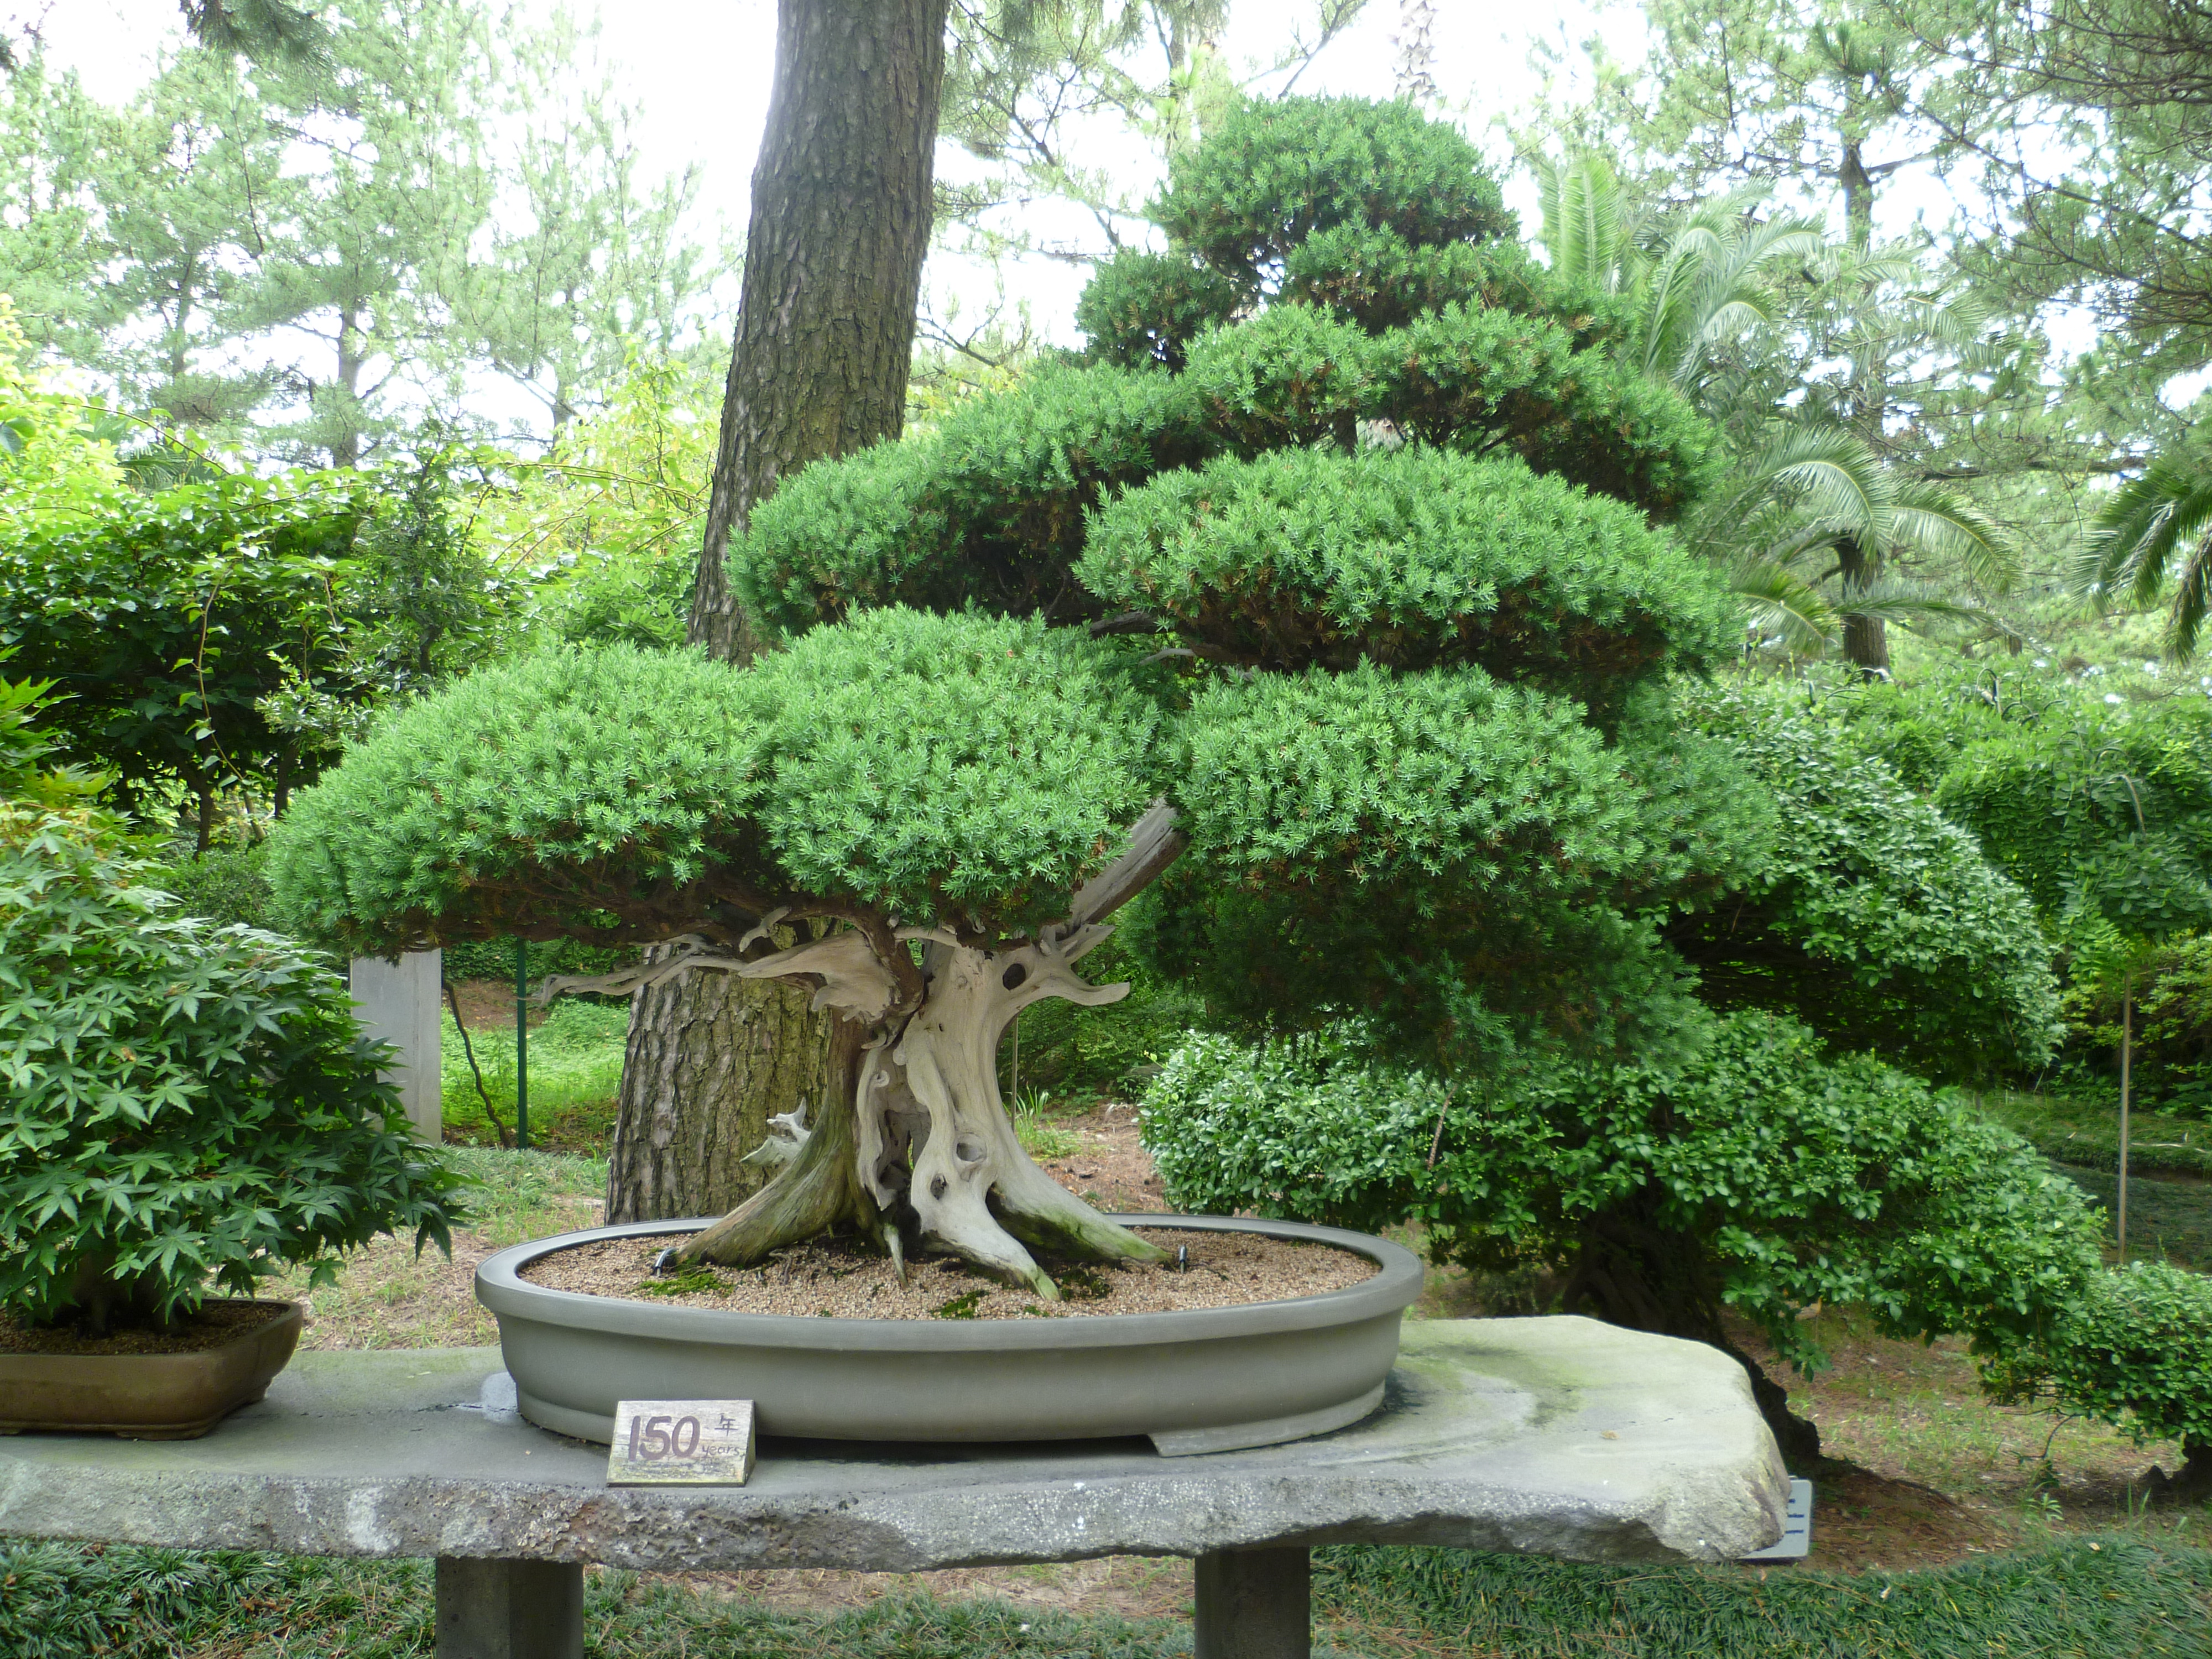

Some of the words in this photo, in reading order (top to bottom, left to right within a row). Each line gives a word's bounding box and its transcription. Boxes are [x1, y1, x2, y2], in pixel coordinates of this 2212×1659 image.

[628, 1415, 701, 1462] 150
[714, 1412, 738, 1437] 年
[702, 1445, 740, 1458] years
